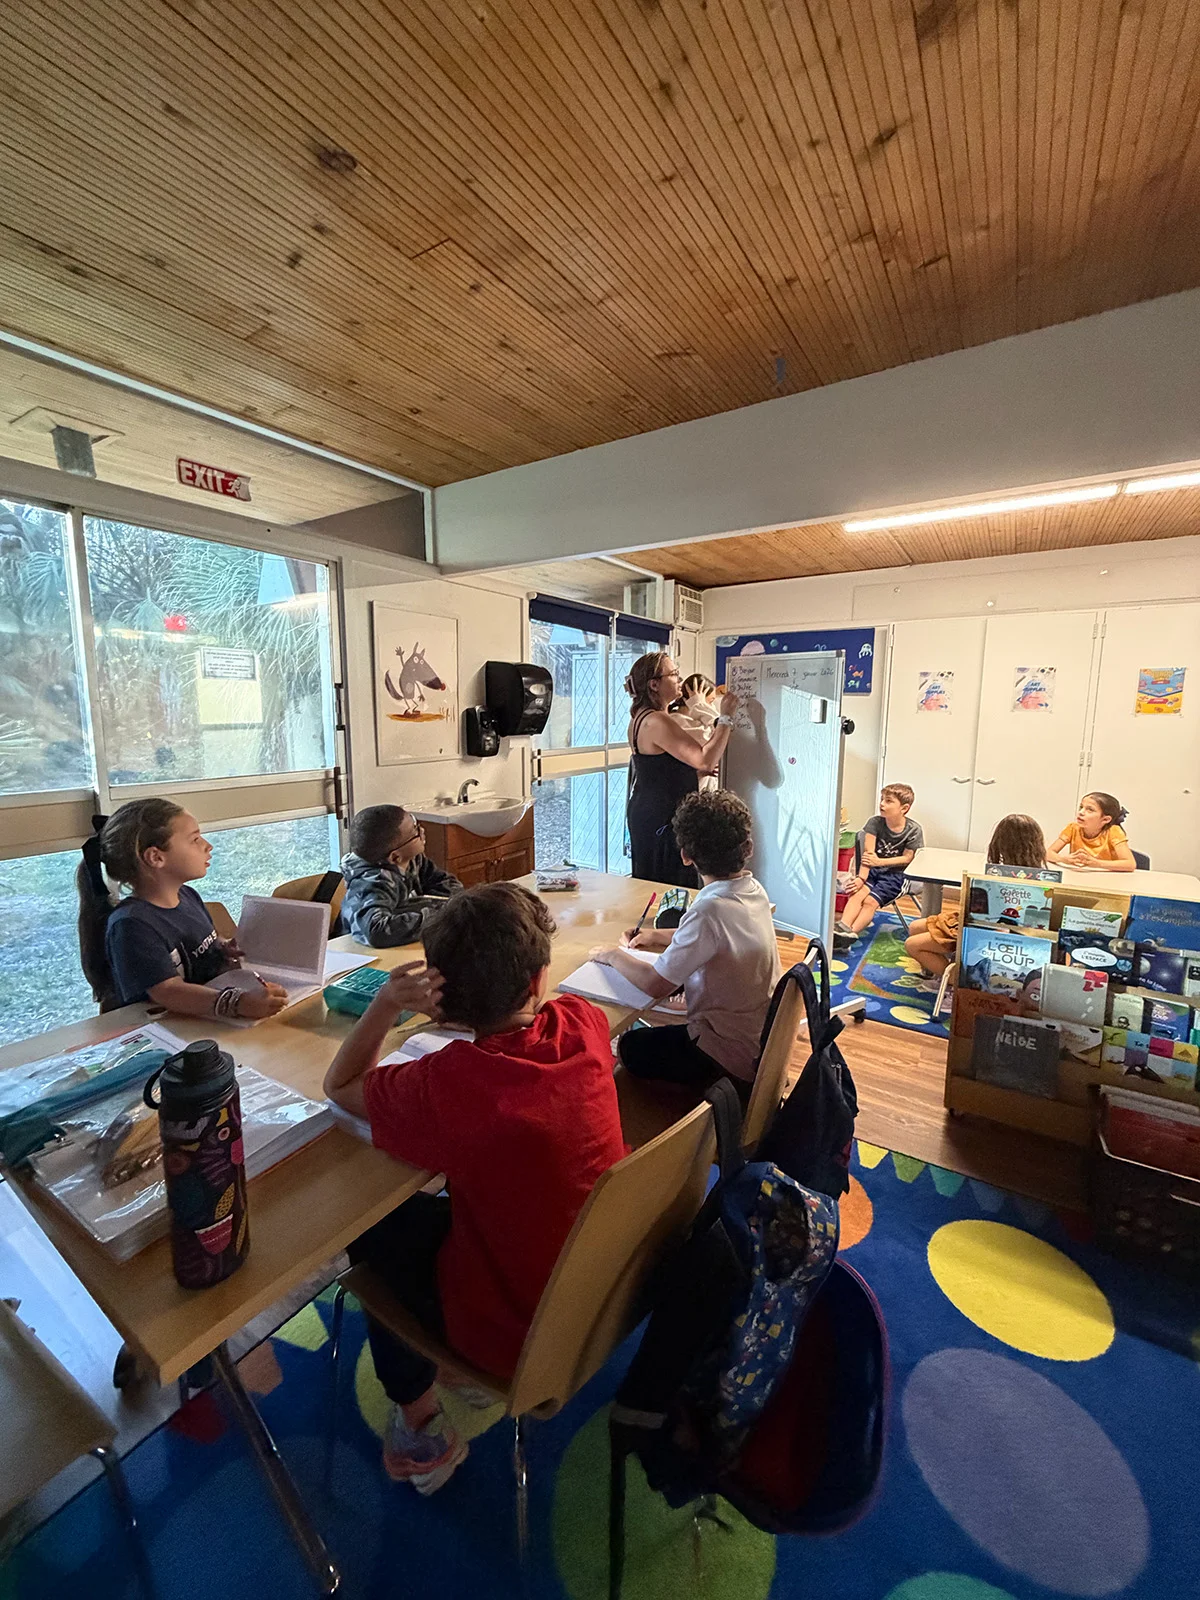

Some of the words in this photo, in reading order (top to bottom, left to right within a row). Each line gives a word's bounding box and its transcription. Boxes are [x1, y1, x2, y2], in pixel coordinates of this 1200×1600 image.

[180, 460, 225, 493] EXIT
[1004, 896, 1020, 905] ROI
[192, 935, 213, 958] YOUTH
[988, 941, 1029, 957] L'ŒIL
[992, 952, 1035, 967] LOUP
